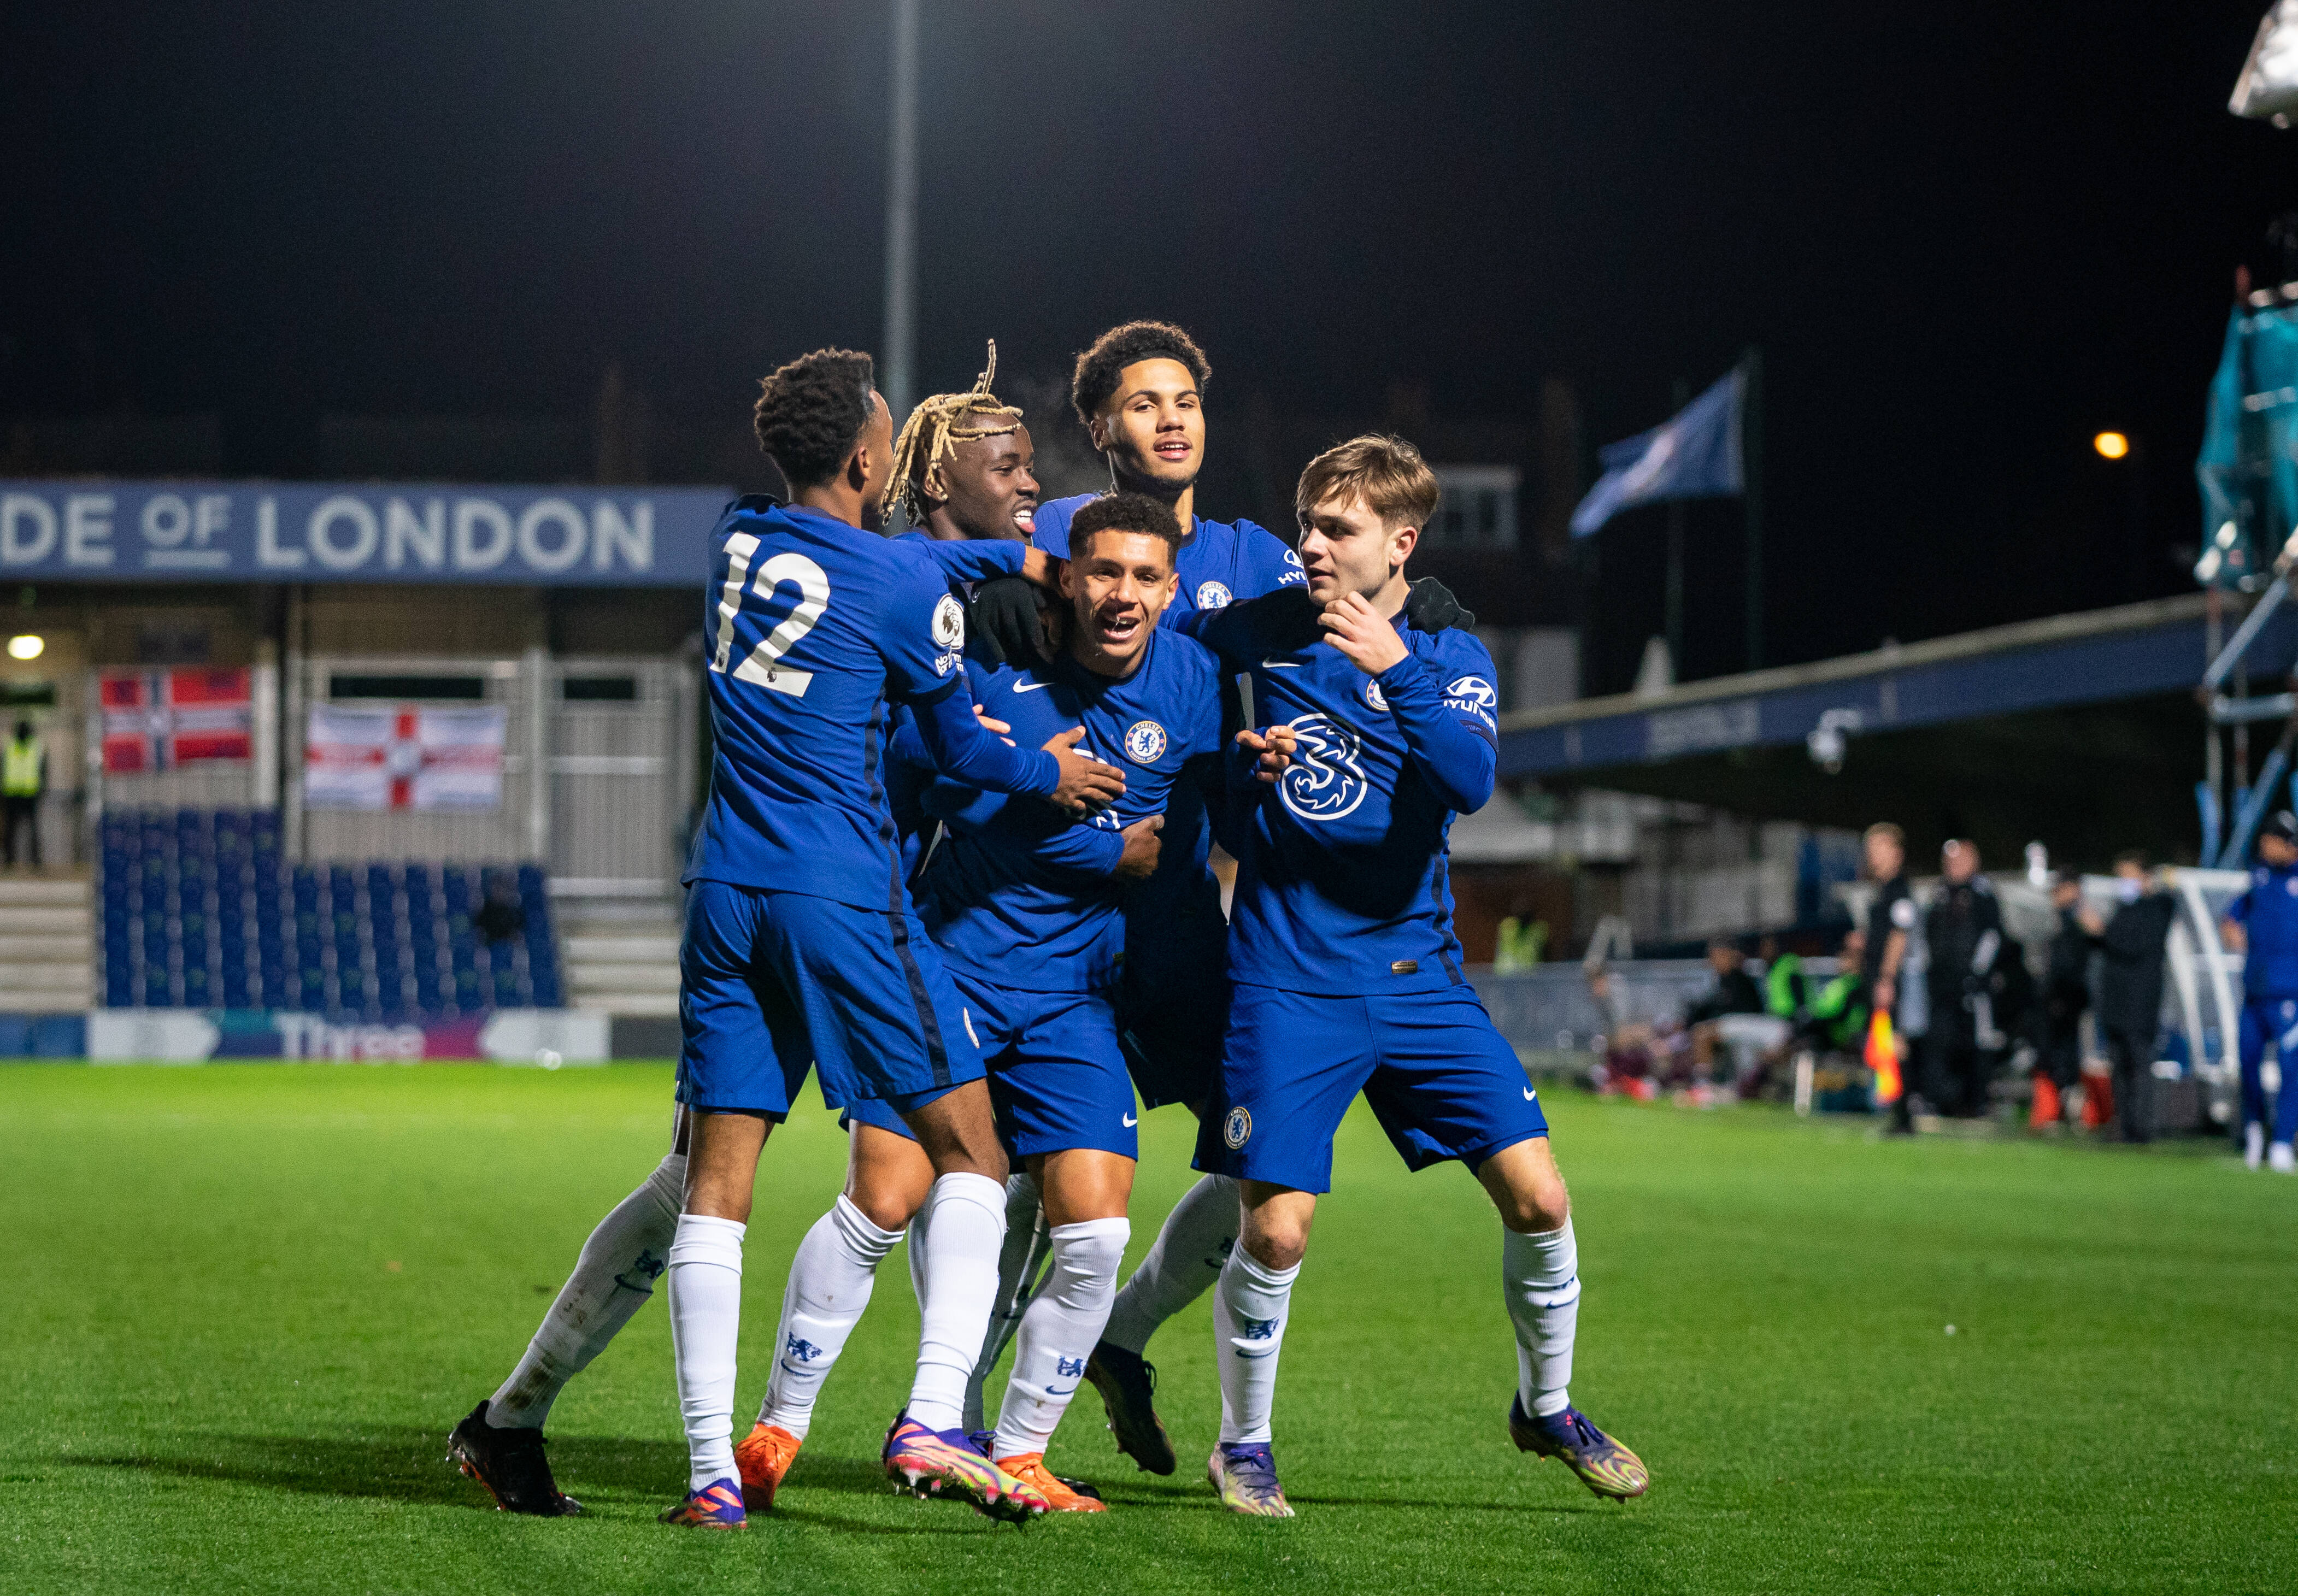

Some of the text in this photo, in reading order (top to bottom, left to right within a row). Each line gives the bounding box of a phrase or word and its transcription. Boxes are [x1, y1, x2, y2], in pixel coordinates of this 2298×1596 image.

[142, 494, 231, 545] OF
[257, 496, 654, 573] LONDON
[710, 532, 831, 698] 12
[1135, 723, 1162, 734] CHELSEA
